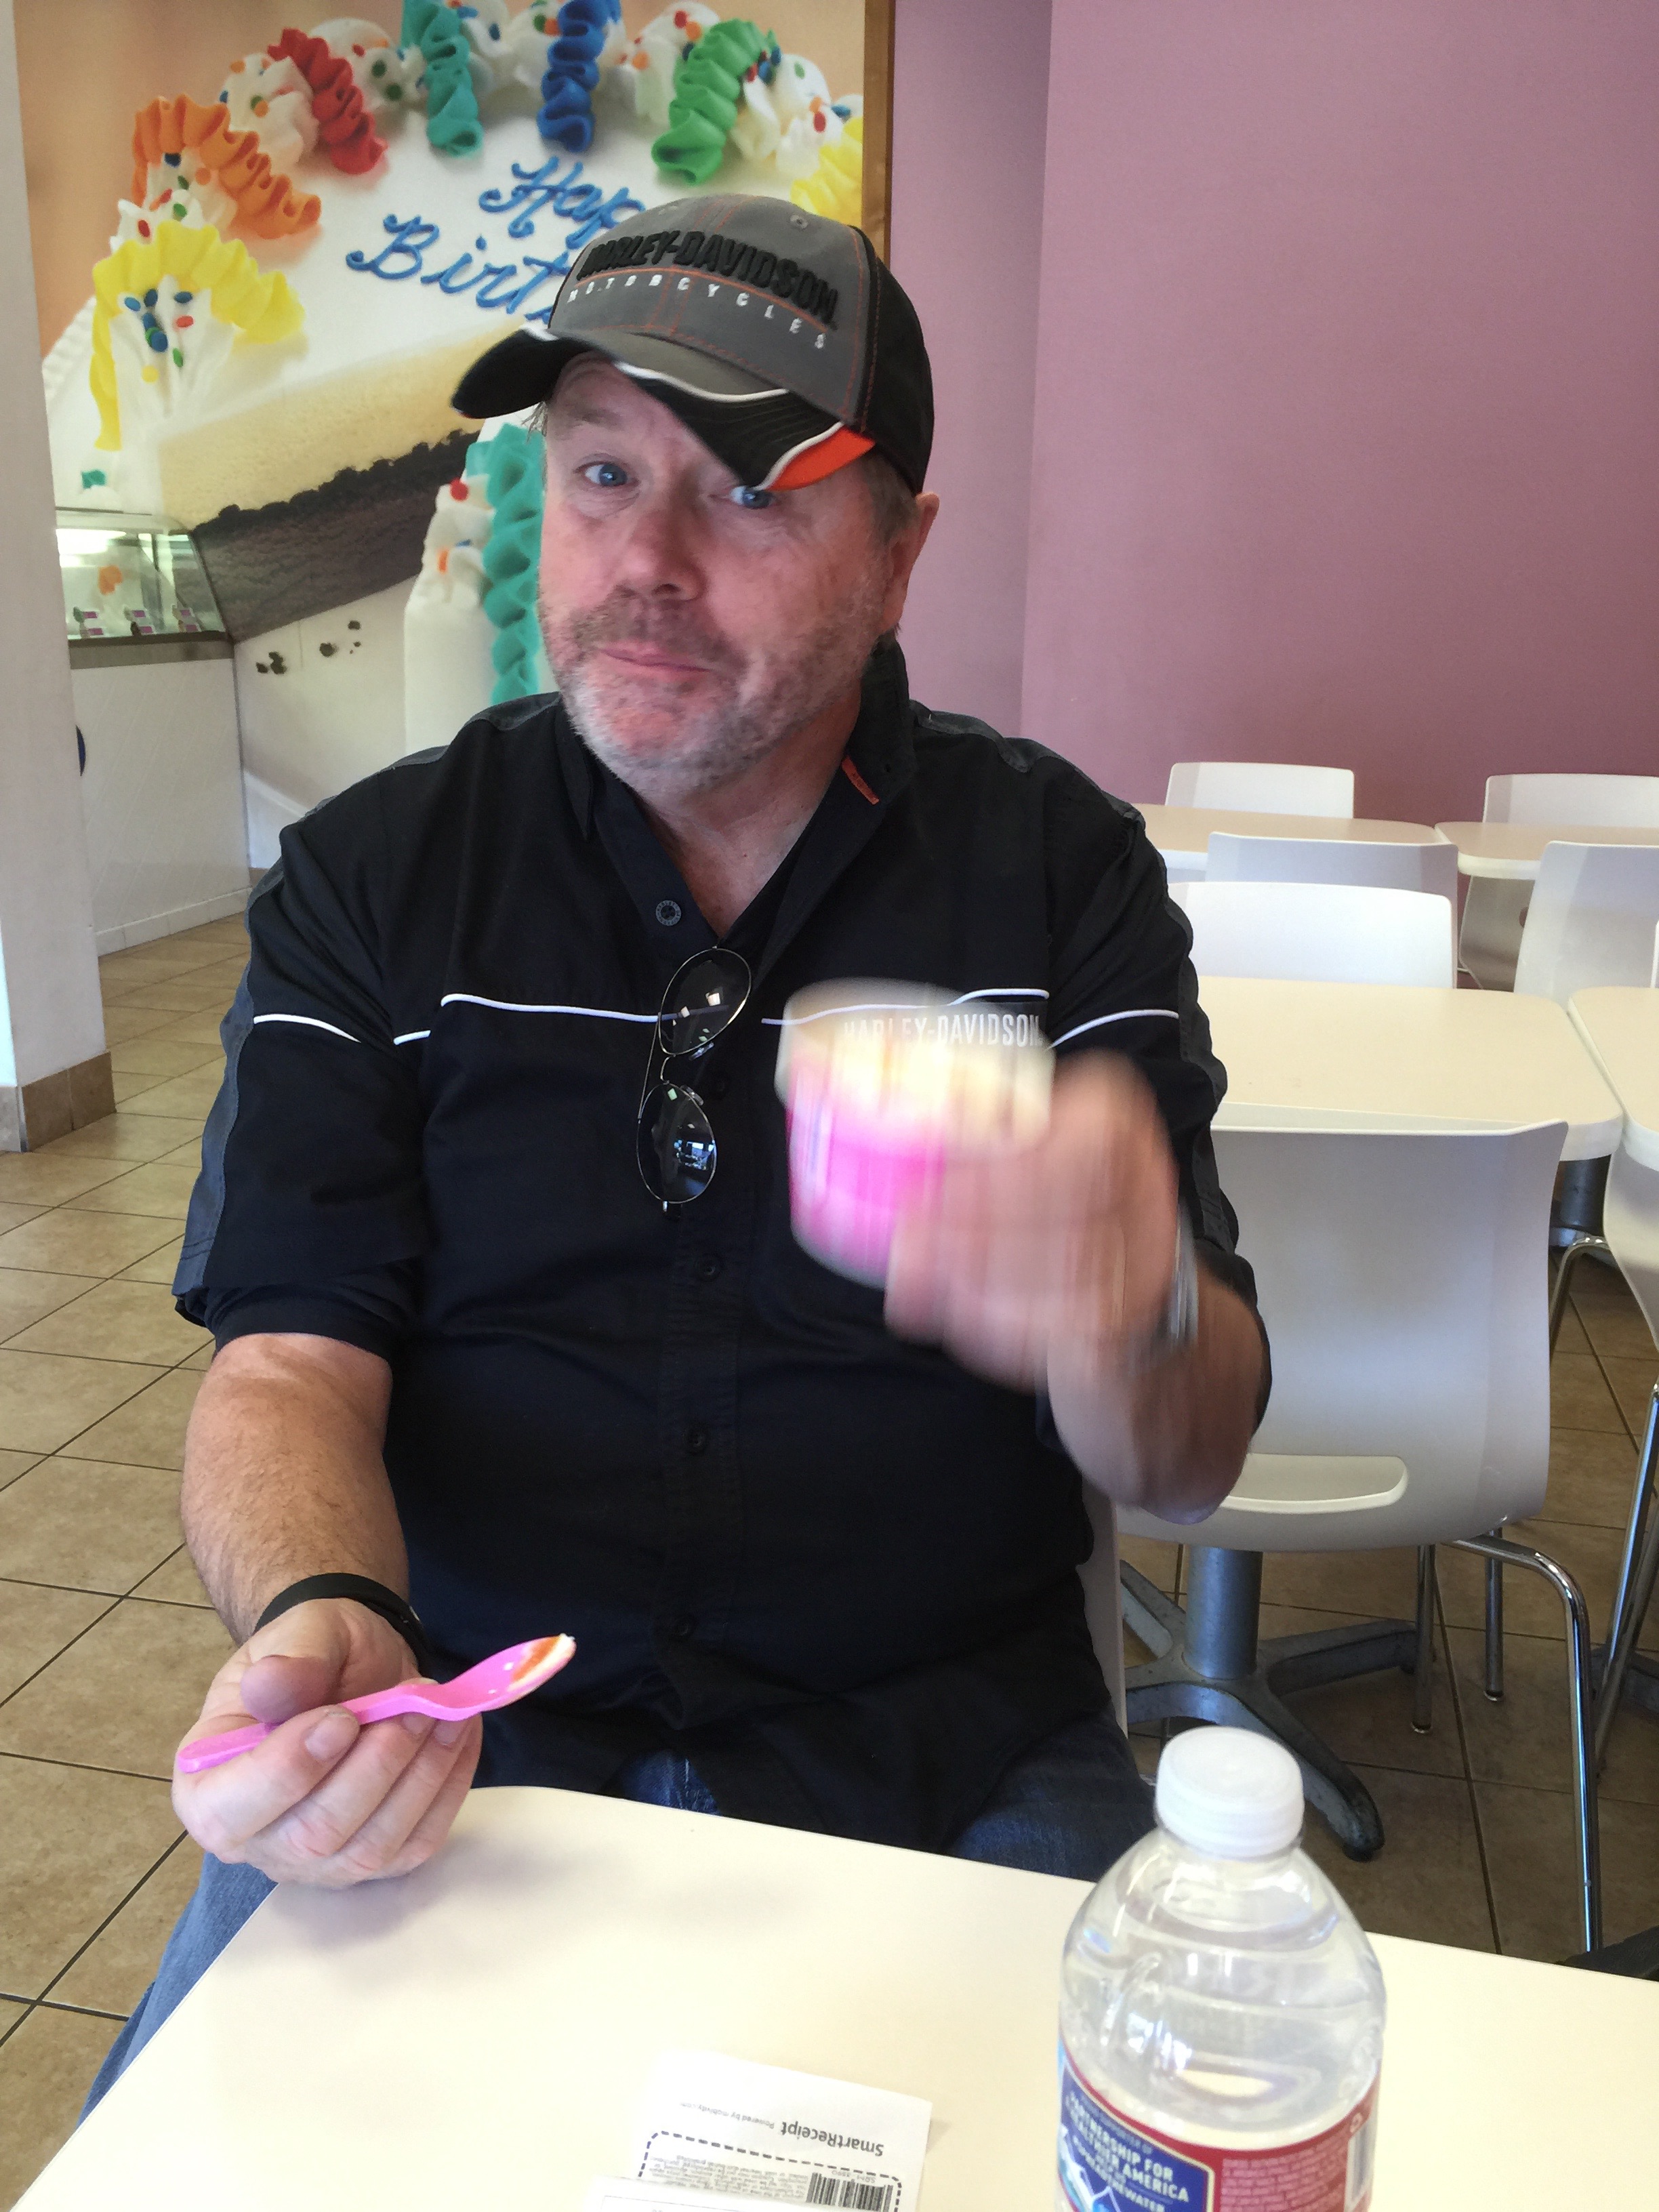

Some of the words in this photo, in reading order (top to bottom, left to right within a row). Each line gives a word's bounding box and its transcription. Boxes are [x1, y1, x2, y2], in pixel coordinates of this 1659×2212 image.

[478, 156, 646, 249] Hap
[346, 213, 573, 324] Birt
[576, 229, 838, 325] HARLEY-DAVIDSON
[567, 273, 827, 349] MOTORCYCLES
[843, 1012, 1044, 1048] HARLEY-DAVIDSON
[731, 2111, 741, 2121] by
[781, 2121, 884, 2156] SmartReceipt
[1122, 2163, 1189, 2203] AMERICA
[1144, 2157, 1174, 2182] FOR
